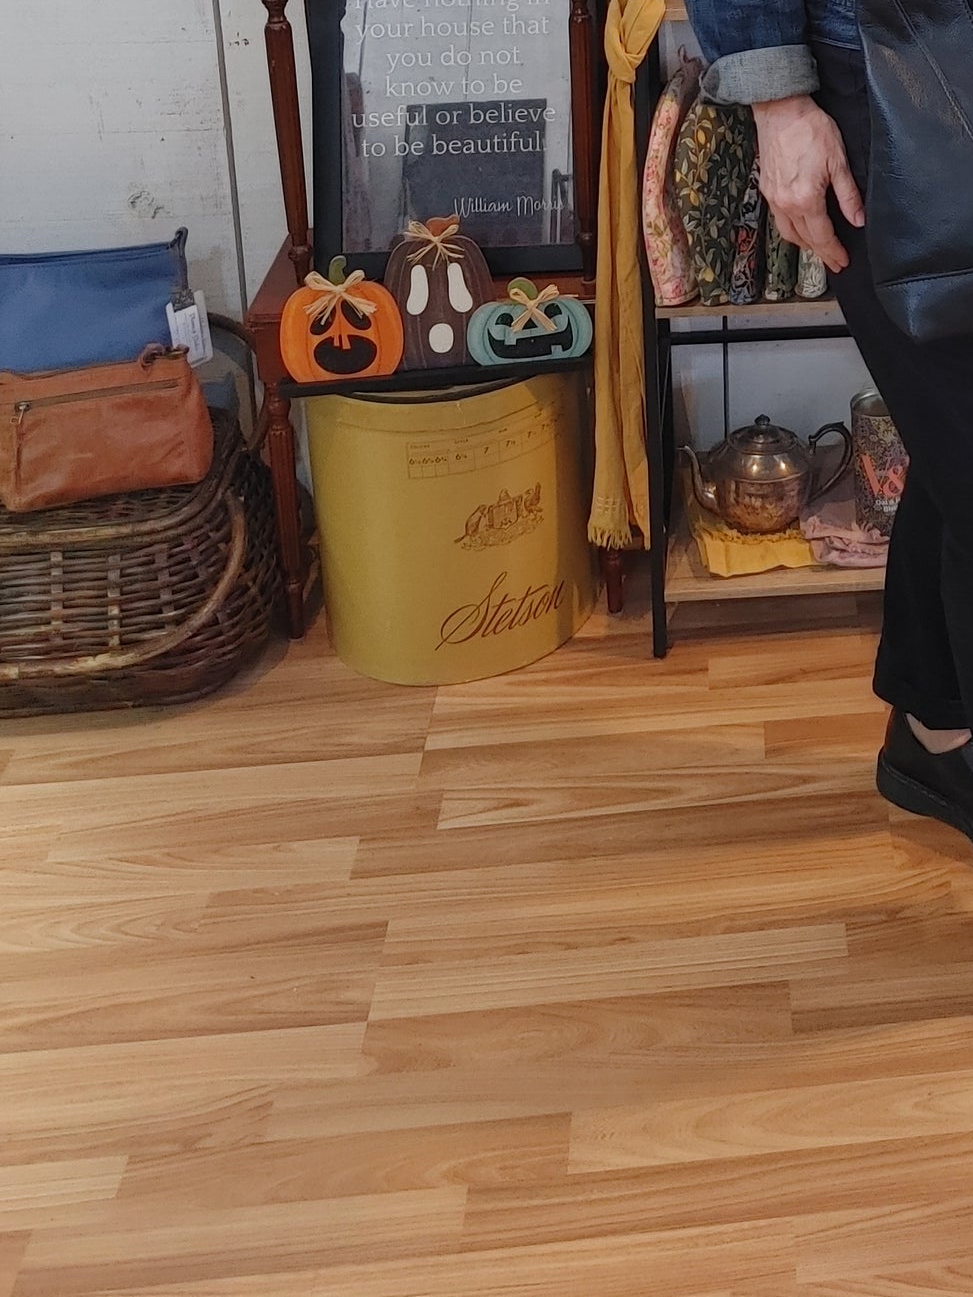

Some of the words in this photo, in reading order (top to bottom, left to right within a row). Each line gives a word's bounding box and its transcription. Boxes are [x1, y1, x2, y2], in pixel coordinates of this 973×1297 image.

[356, 22, 413, 45] your
[420, 17, 494, 37] house
[502, 15, 549, 35] that
[386, 51, 432, 73] you
[441, 45, 472, 66] do
[479, 46, 520, 65] not
[385, 76, 453, 97] know
[462, 78, 484, 94] to
[493, 74, 522, 94] be
[352, 104, 427, 128] useful
[436, 109, 462, 126] or
[469, 103, 556, 125] believe
[362, 139, 386, 157] to
[394, 137, 424, 157] be
[454, 196, 512, 219] William
[516, 196, 564, 216] Morris
[435, 571, 565, 651] Stetson
